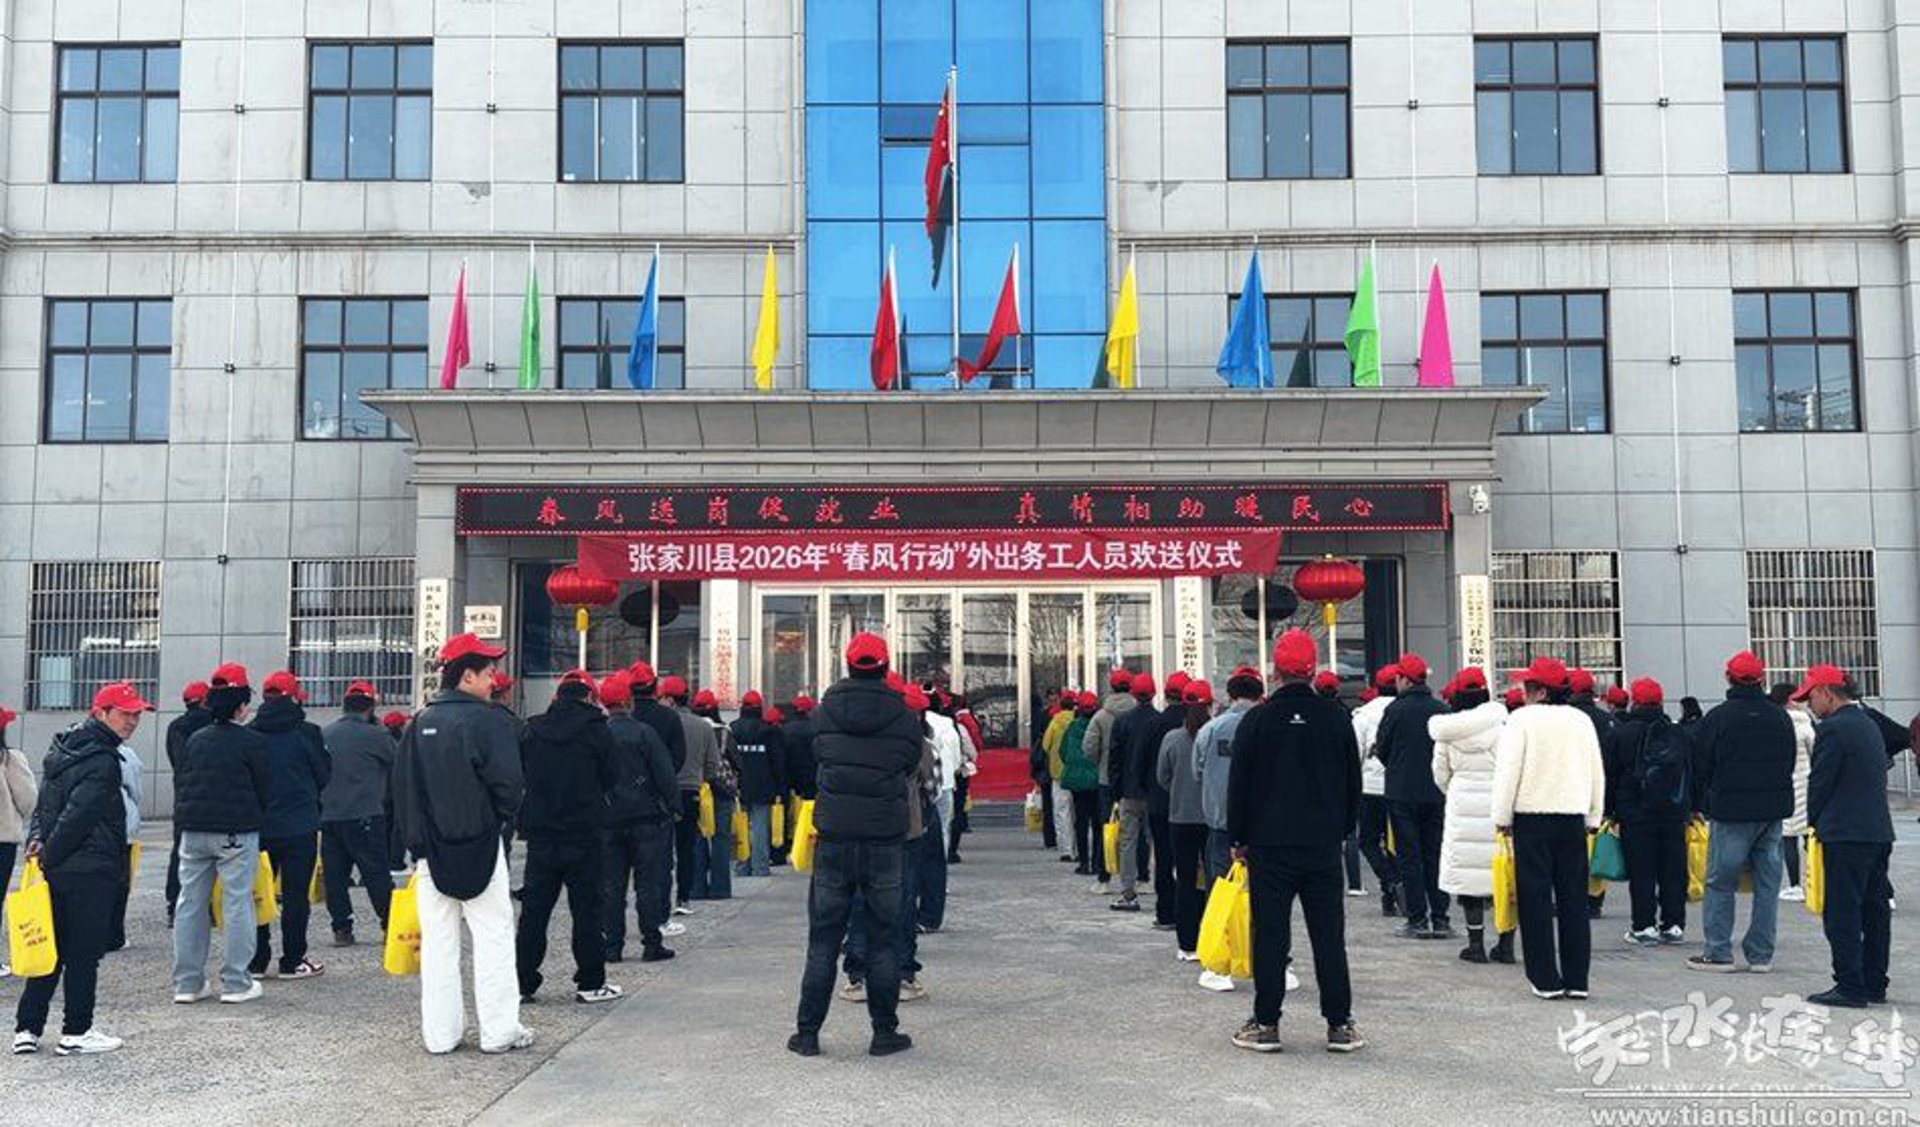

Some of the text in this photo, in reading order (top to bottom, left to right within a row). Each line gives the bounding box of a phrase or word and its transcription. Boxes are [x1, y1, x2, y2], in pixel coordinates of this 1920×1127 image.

[537, 492, 1374, 526] 春风送岗促就业 真情相助暖民心
[628, 540, 1243, 572] 张家川县2026年“春风行动”外出务工人员欢送仪式
